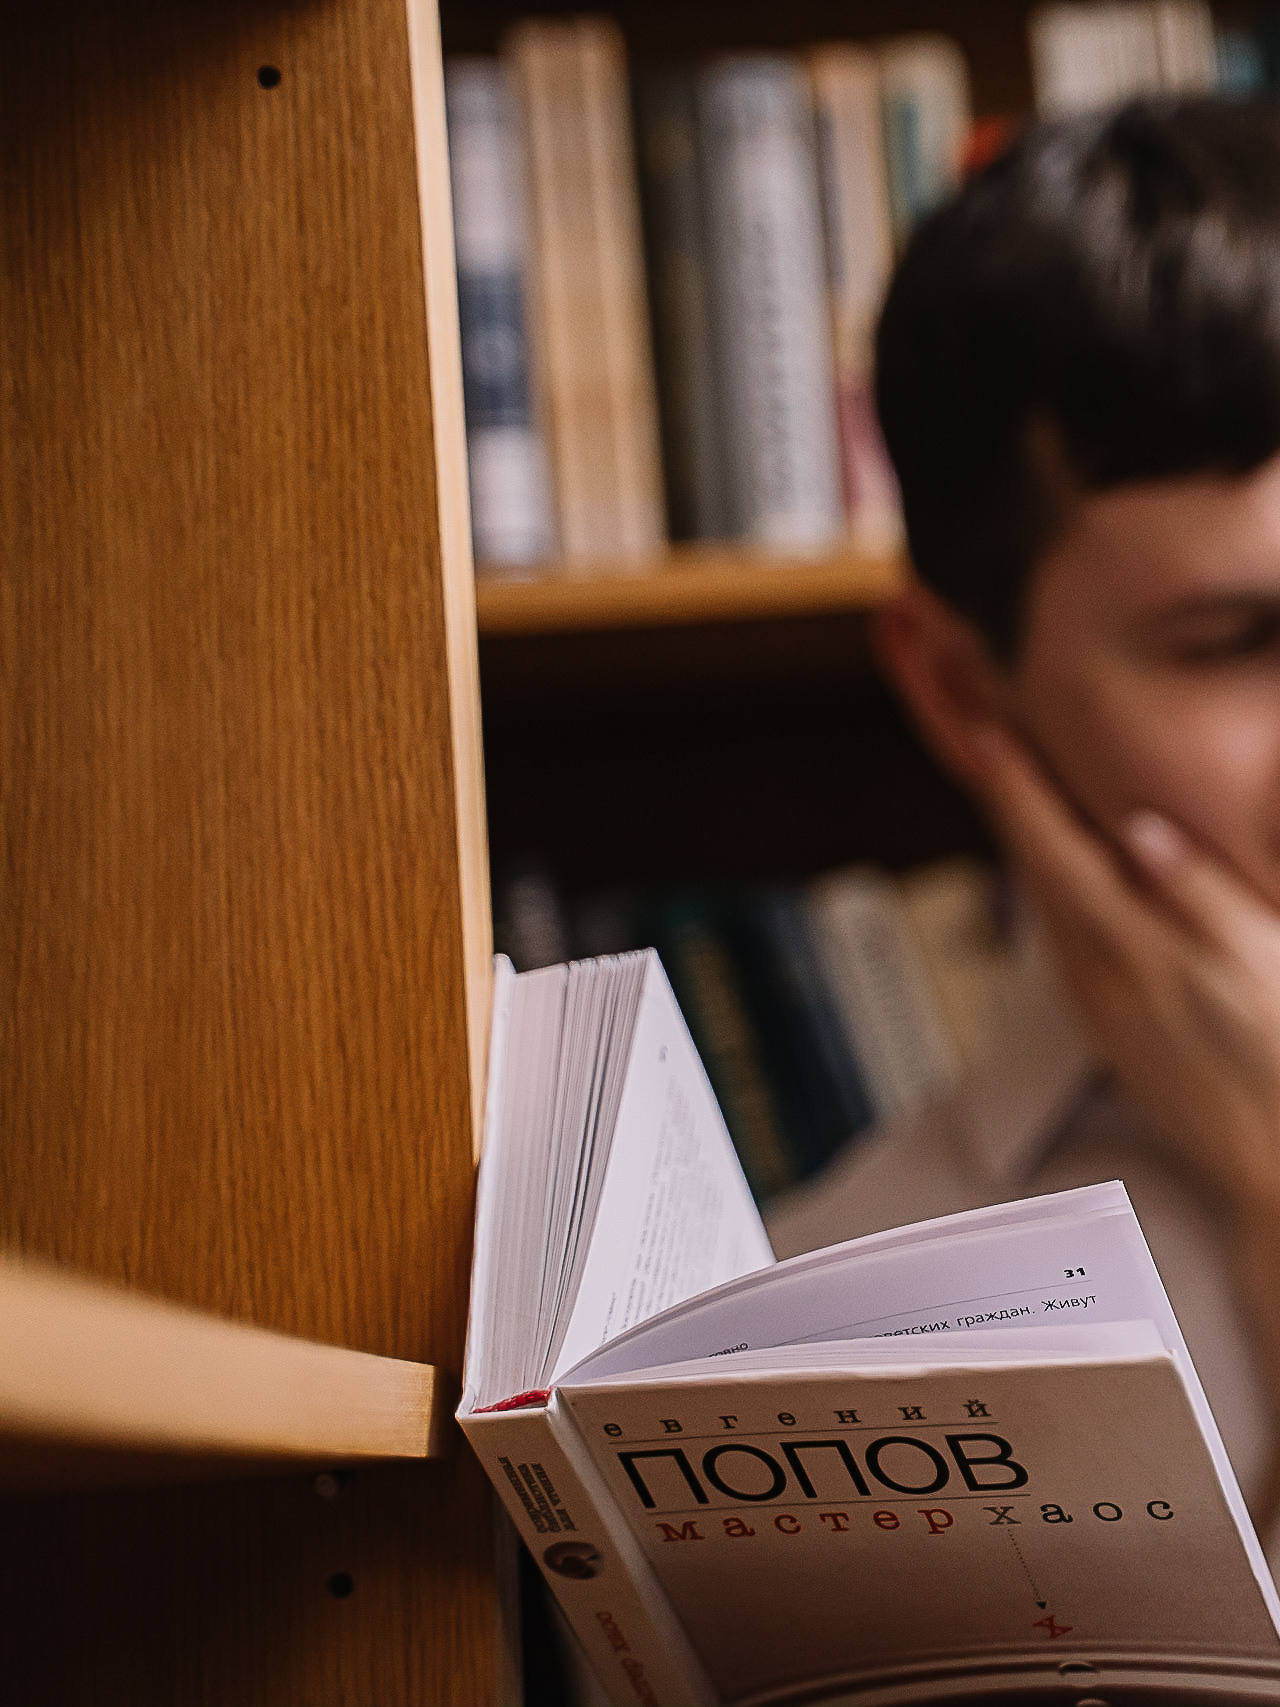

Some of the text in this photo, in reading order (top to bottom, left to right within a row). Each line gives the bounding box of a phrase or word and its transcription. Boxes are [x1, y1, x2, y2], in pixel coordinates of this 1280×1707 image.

[1063, 1267, 1086, 1279] 31
[956, 1306, 1036, 1328] граждан.
[1041, 1295, 1097, 1313] Живут
[616, 1432, 1029, 1509] ПОПОВ
[655, 1500, 1175, 1543] мастер хаос
